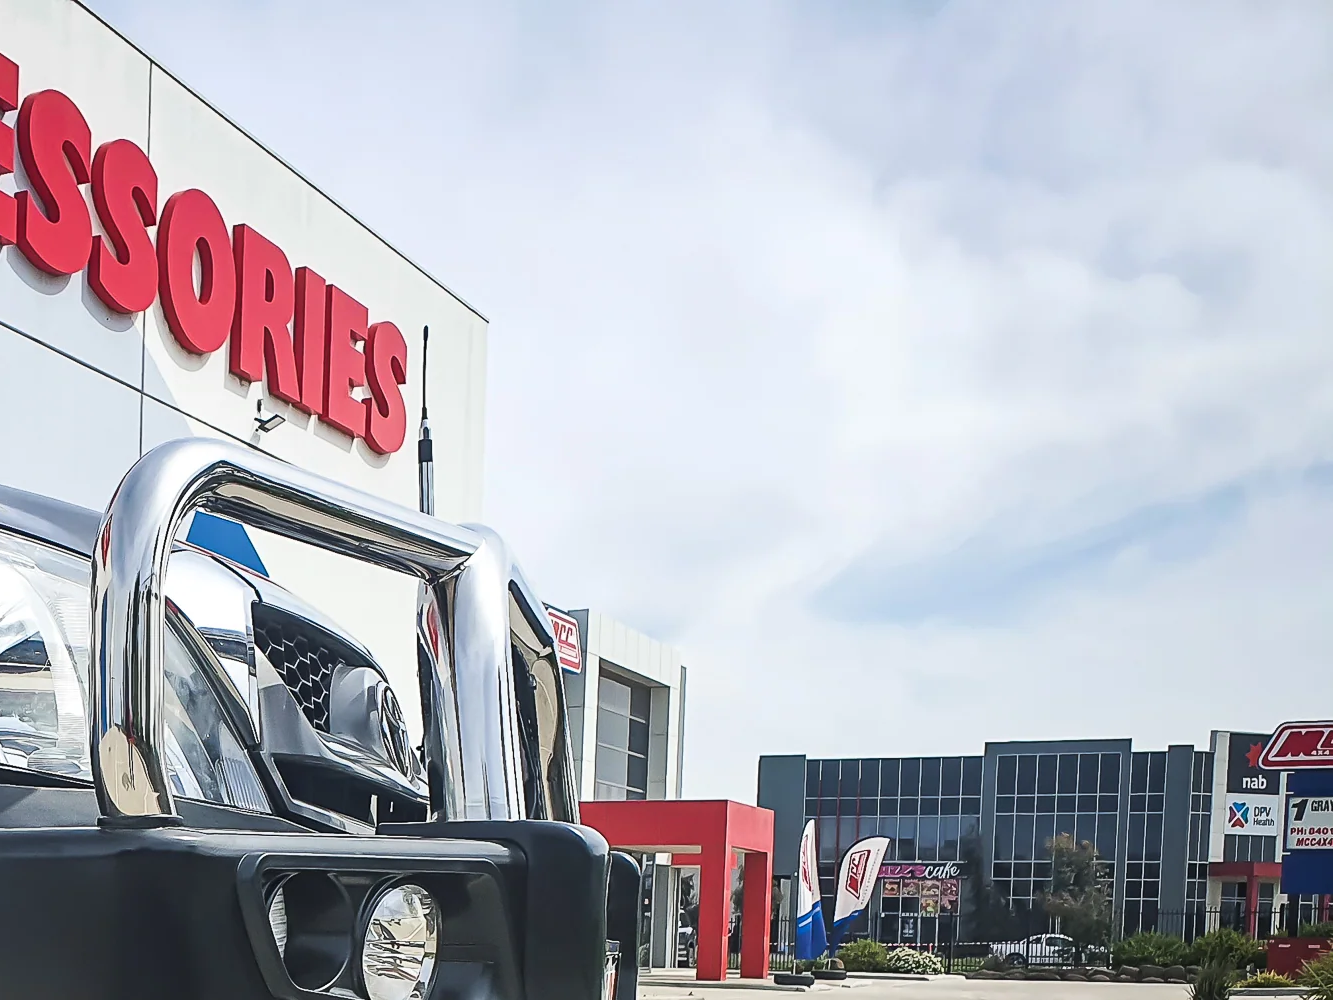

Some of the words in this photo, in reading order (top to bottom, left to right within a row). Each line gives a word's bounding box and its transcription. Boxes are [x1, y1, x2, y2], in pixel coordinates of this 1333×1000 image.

[1242, 774, 1267, 790] nab
[1253, 806, 1272, 818] DPV
[1291, 798, 1309, 822] 1
[1253, 818, 1275, 827] Health
